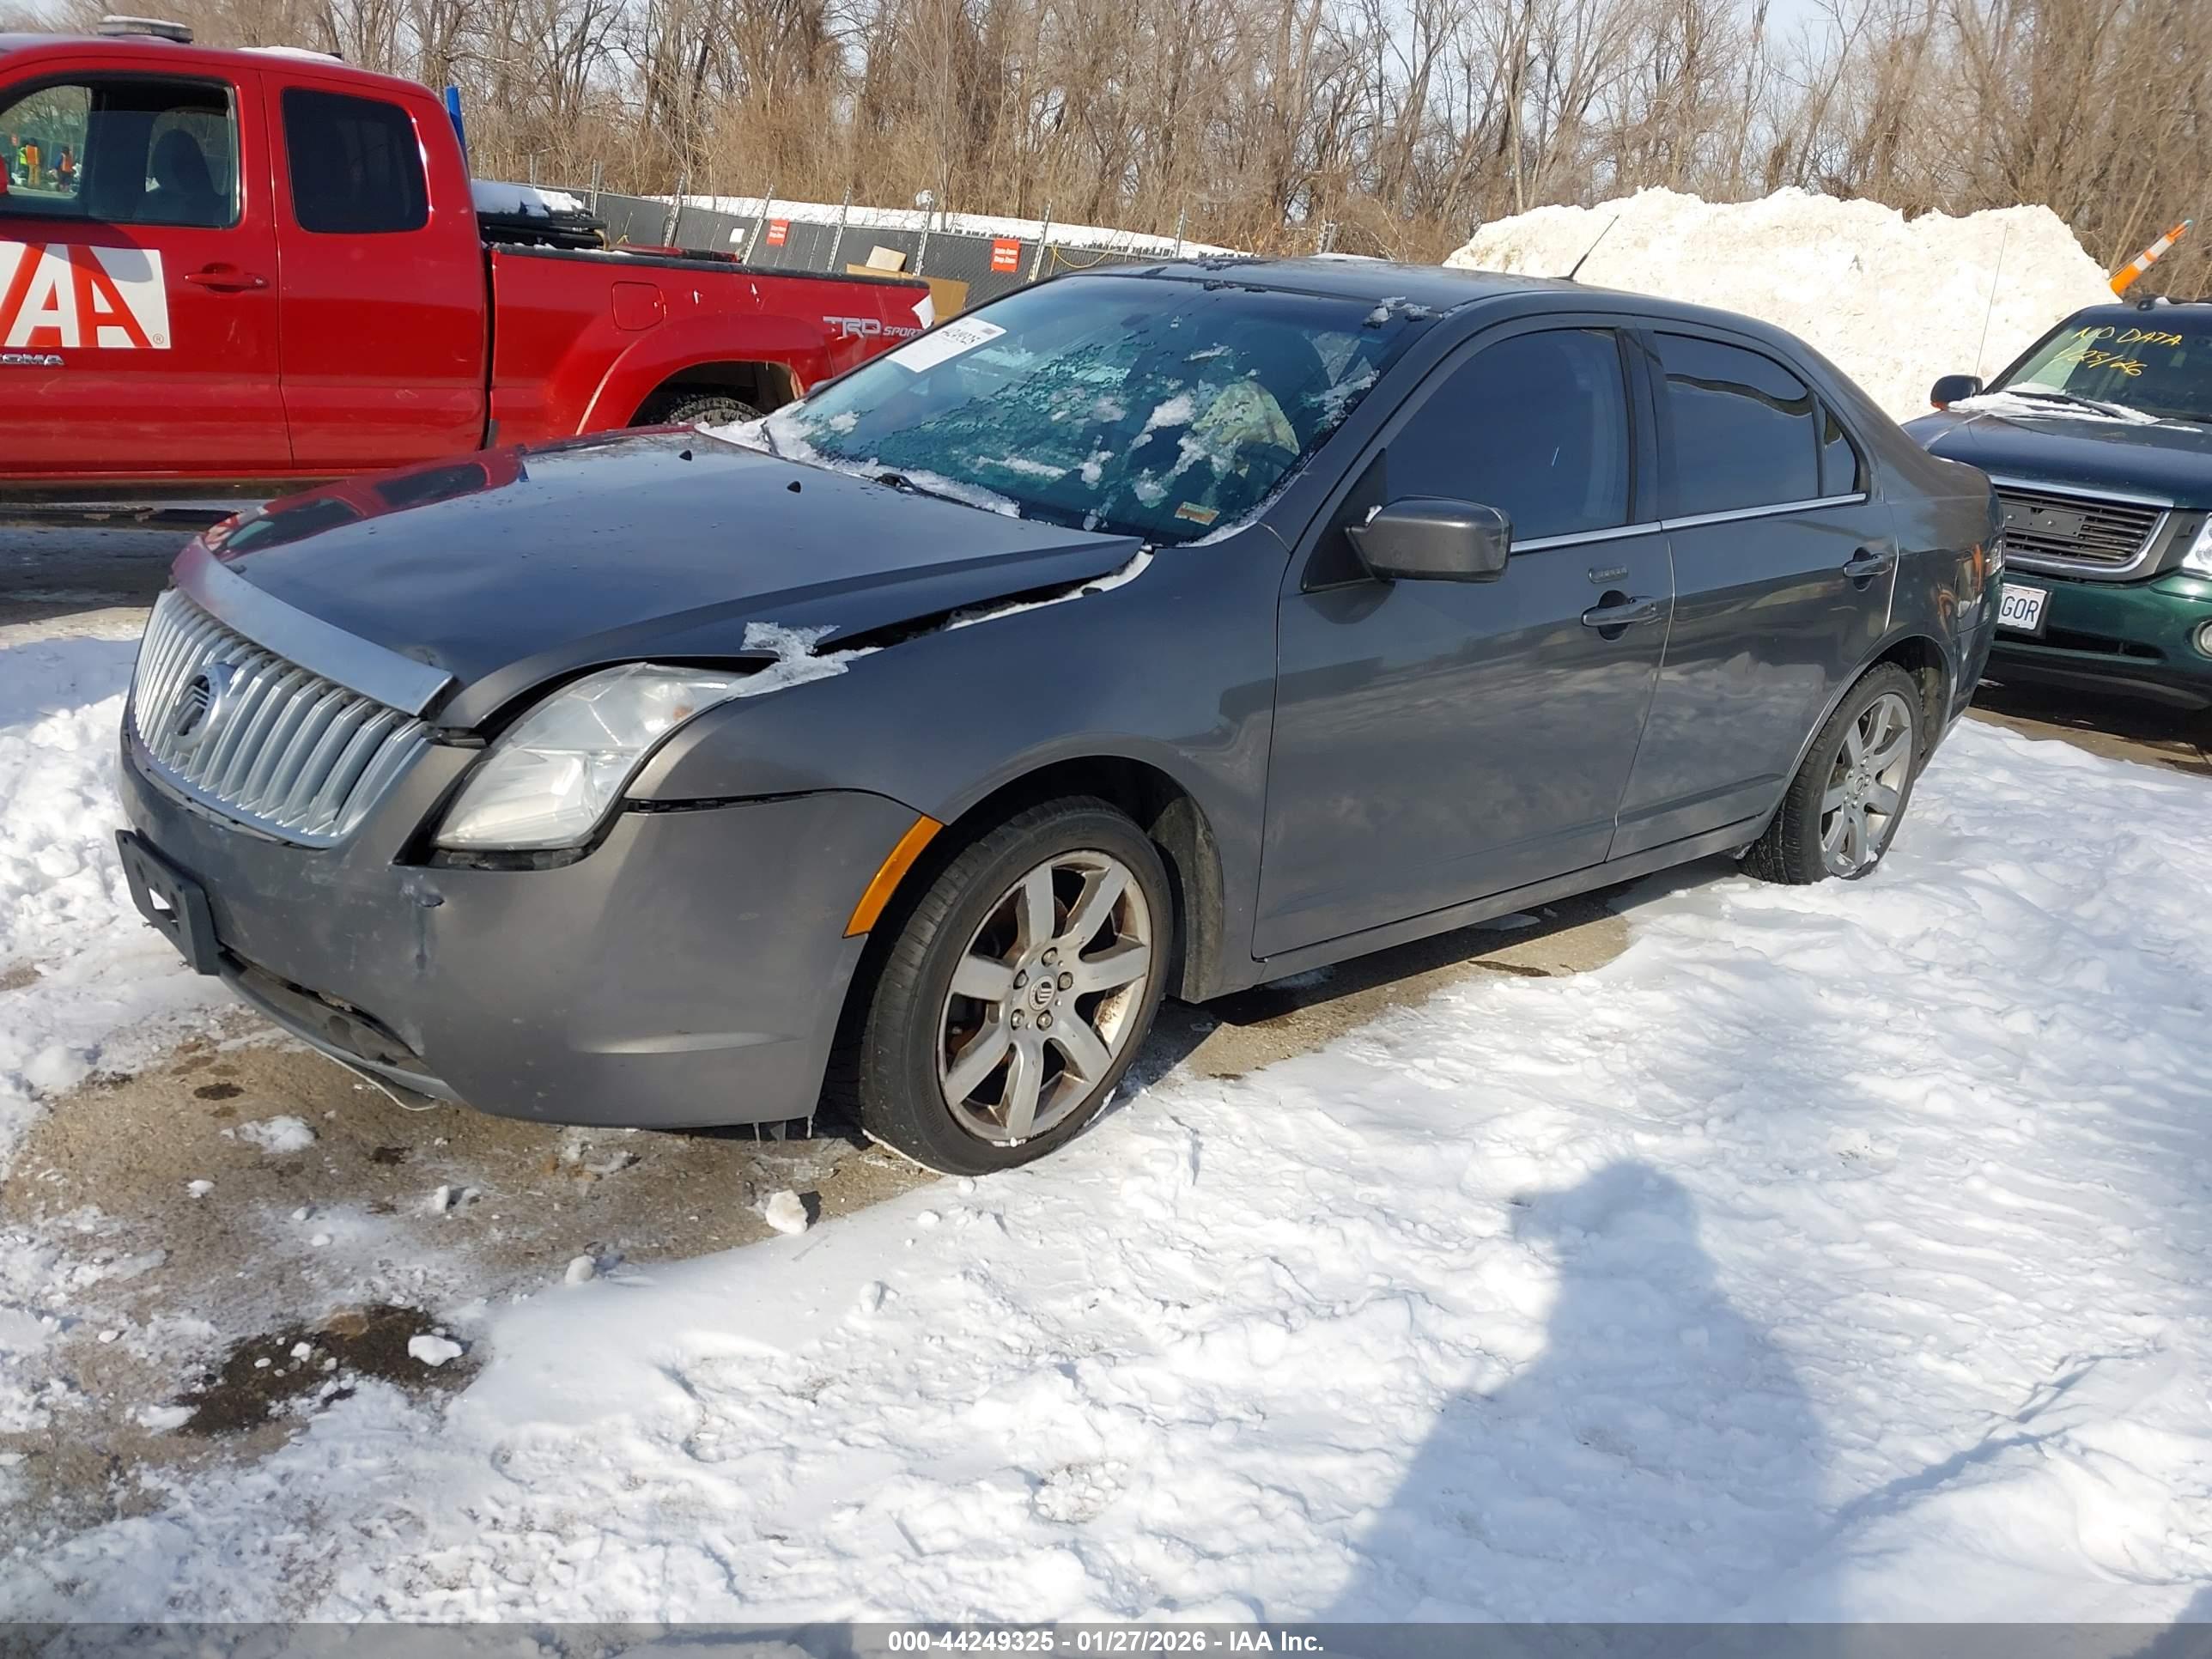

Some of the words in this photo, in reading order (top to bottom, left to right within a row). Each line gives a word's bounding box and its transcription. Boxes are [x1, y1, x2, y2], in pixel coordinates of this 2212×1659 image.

[823, 316, 881, 340] TRD
[2070, 326, 2115, 340] NO
[2116, 328, 2183, 346] DATA
[0, 354, 64, 366] OMA
